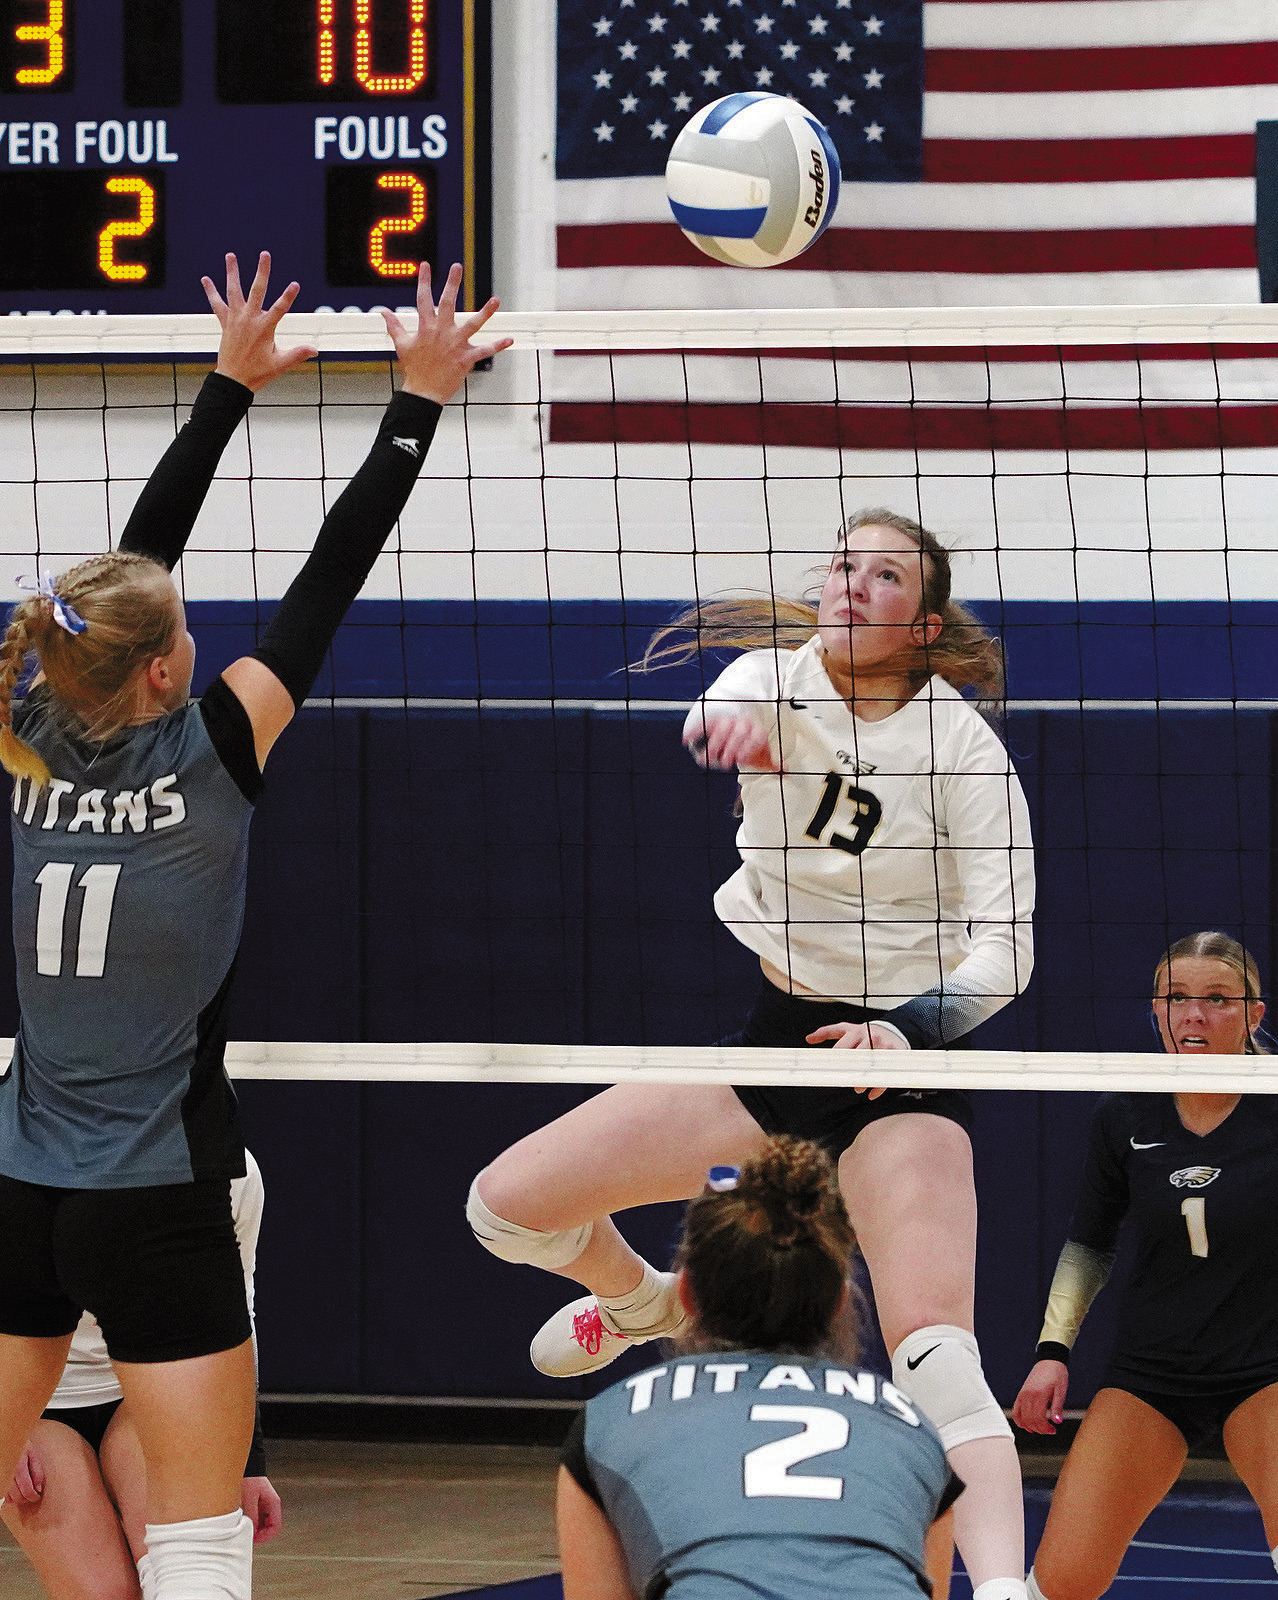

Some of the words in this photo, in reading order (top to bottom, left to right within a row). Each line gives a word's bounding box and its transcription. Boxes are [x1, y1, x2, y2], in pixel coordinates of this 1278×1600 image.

[0, 120, 60, 165] ER
[75, 120, 179, 164] FOUL
[313, 114, 449, 160] FOULS
[98, 176, 155, 281] 2
[370, 173, 425, 277] 2
[804, 149, 824, 228] Baden
[804, 770, 883, 856] 13
[34, 861, 123, 978] 11
[1181, 1197, 1209, 1258] 1
[625, 1363, 921, 1428] TITANS
[743, 1403, 850, 1500] 2
